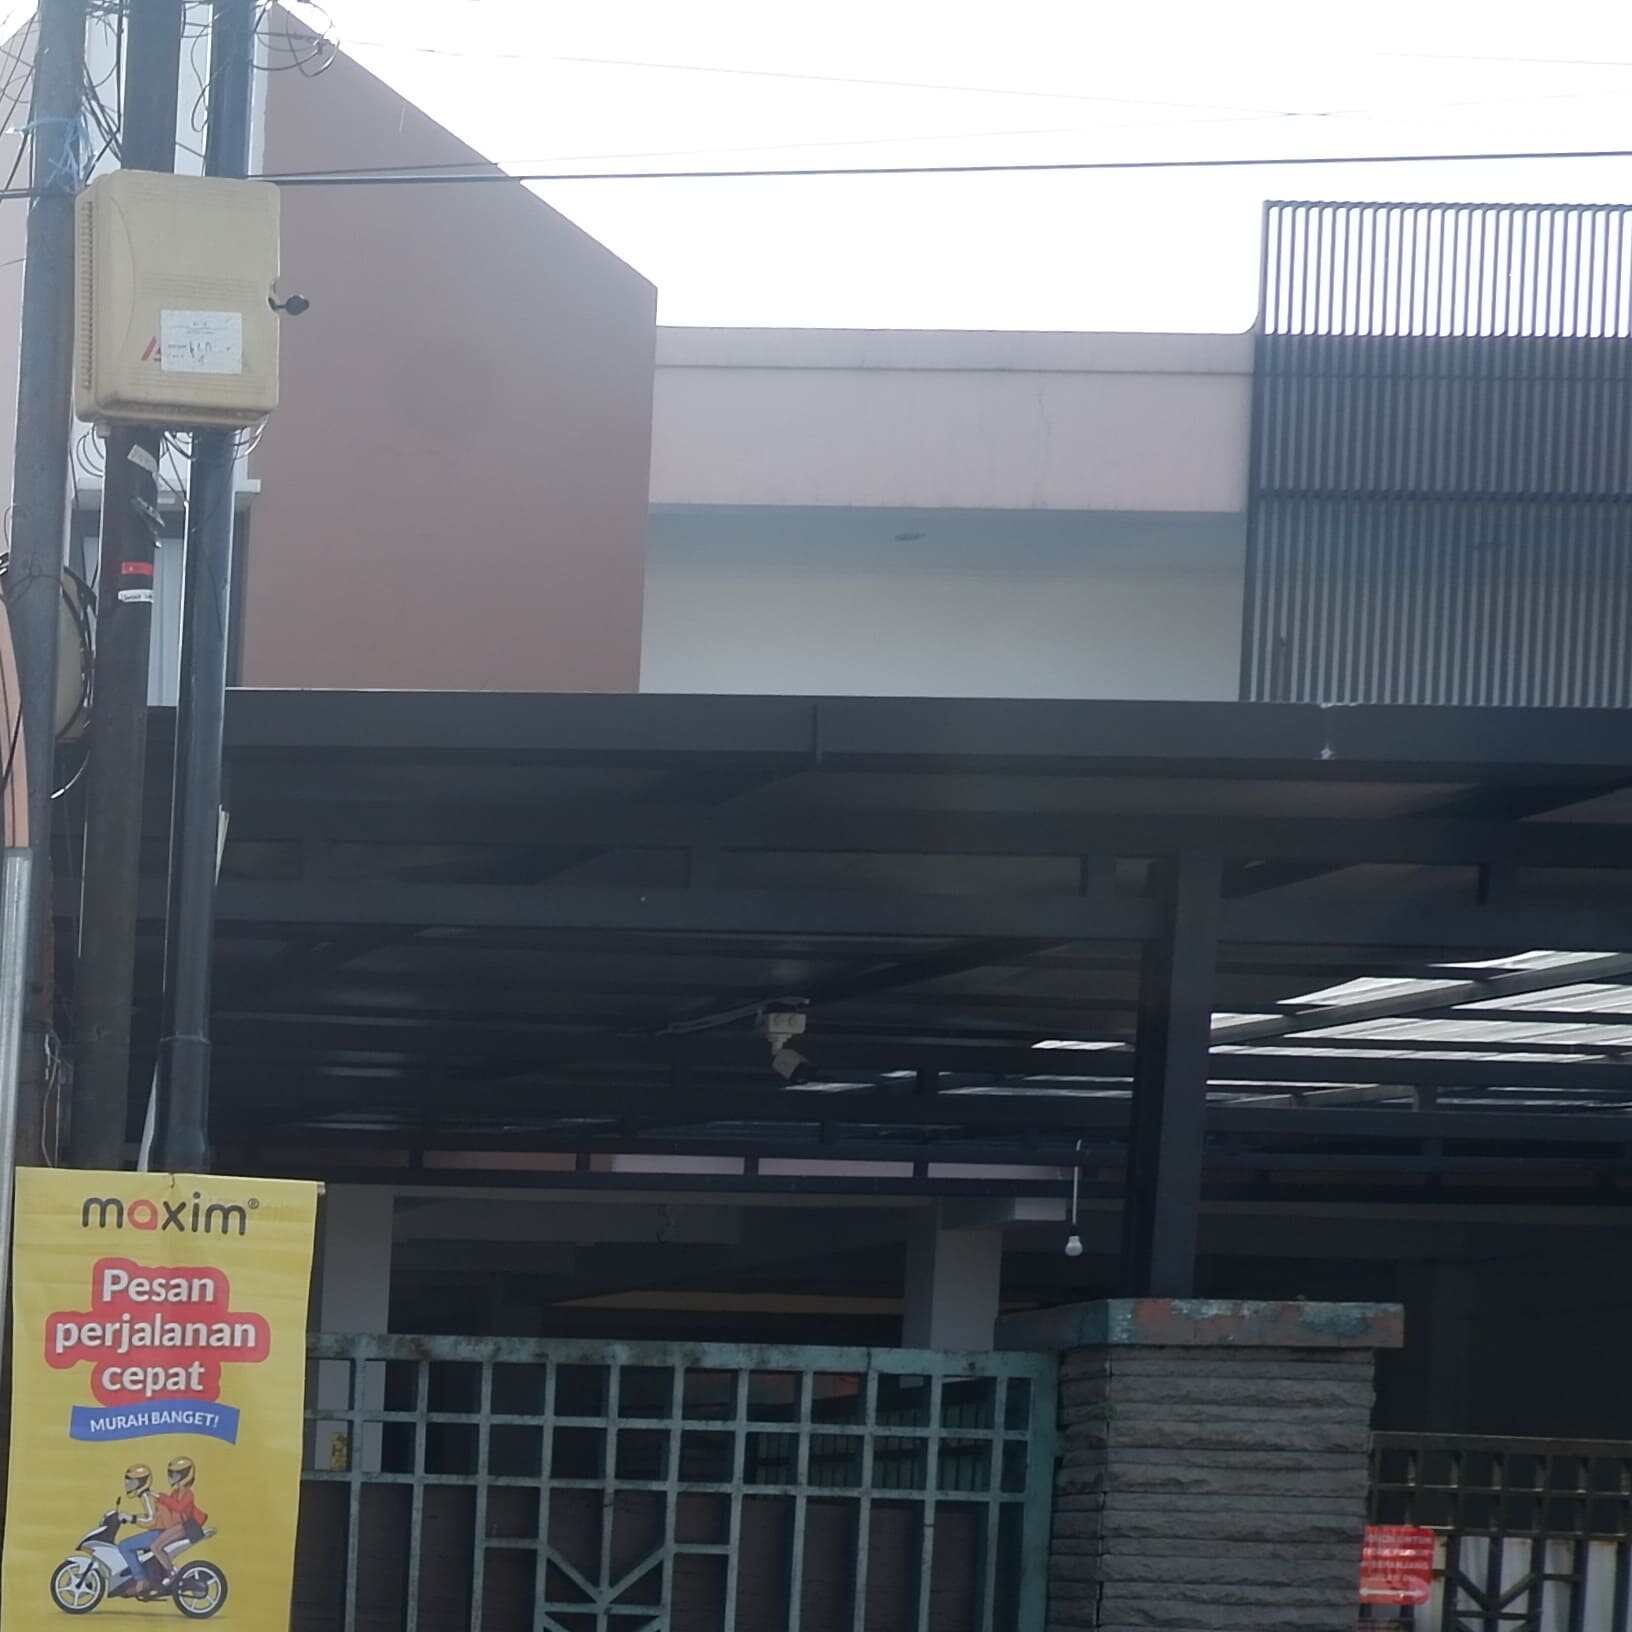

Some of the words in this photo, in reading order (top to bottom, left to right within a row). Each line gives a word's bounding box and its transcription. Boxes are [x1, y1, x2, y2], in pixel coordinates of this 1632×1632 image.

[82, 1192, 247, 1237] maxim
[102, 1268, 216, 1303] Pesan
[54, 1313, 257, 1353] perjalanan
[101, 1360, 206, 1397] cepat
[89, 1413, 149, 1433] MURAH
[151, 1410, 220, 1429] BANGET!
